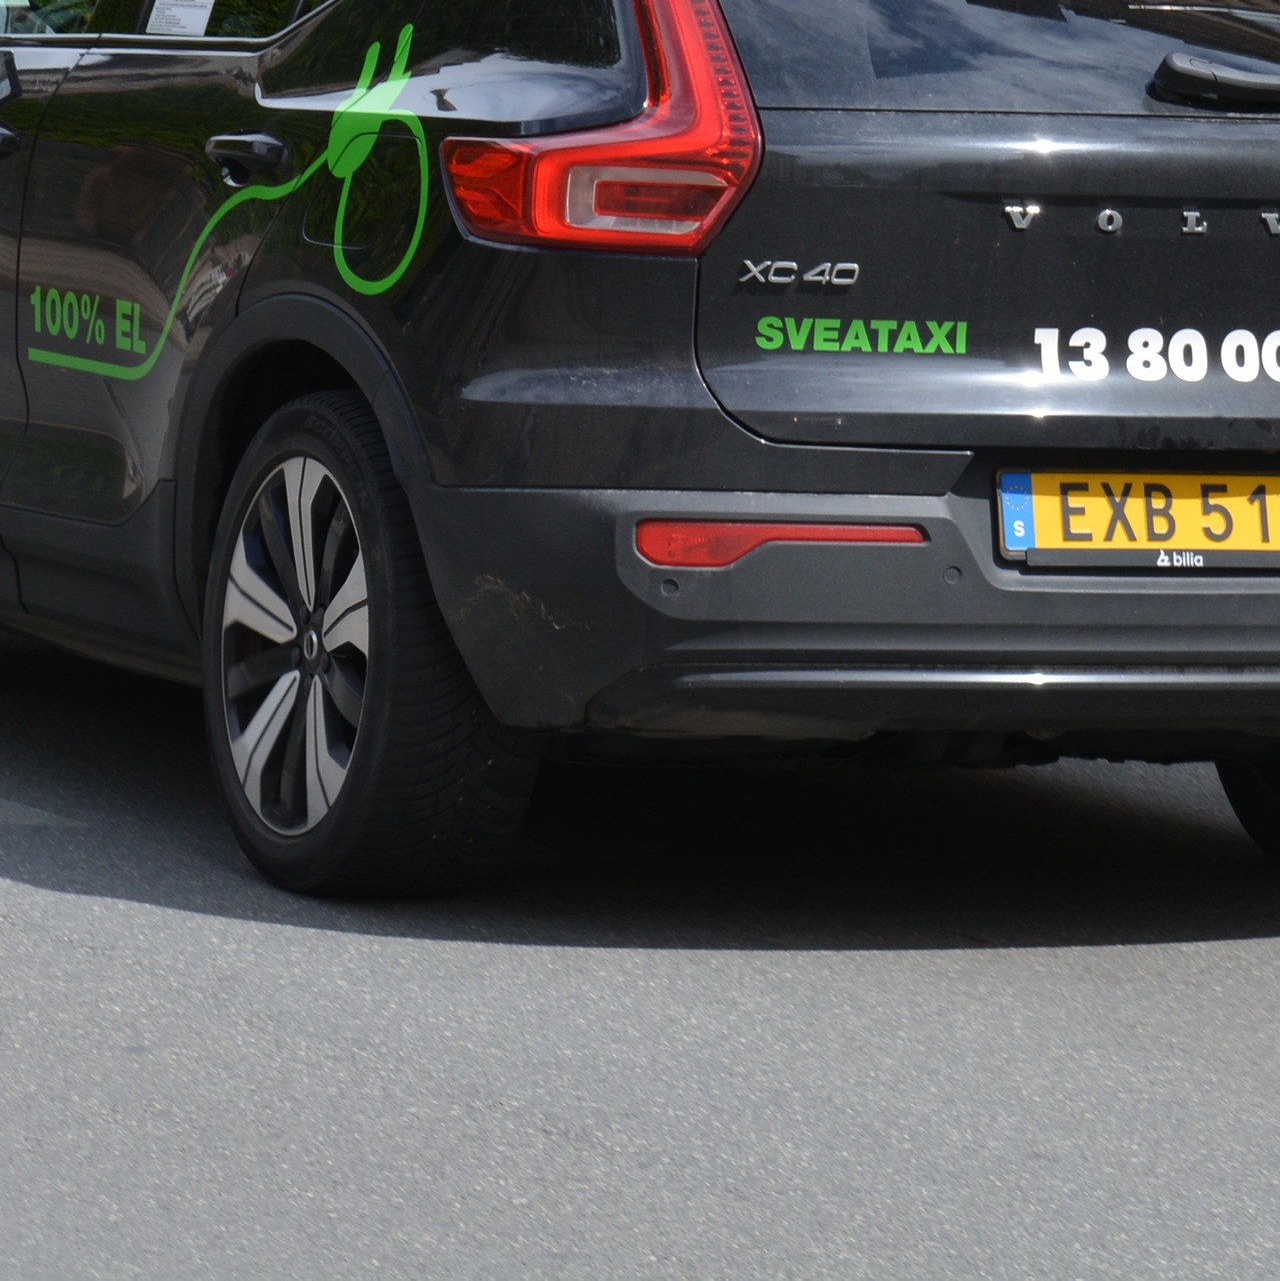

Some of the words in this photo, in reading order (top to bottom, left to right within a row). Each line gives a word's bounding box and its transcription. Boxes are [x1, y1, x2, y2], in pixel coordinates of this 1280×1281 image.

[30, 284, 105, 346] 100%
[116, 297, 147, 355] EL
[754, 316, 968, 356] SVEATAXI
[1032, 327, 1110, 383] 13
[1126, 327, 1208, 384] 80
[1012, 519, 1026, 538] S
[1059, 481, 1176, 543] EXB
[1173, 549, 1204, 567] bilia
